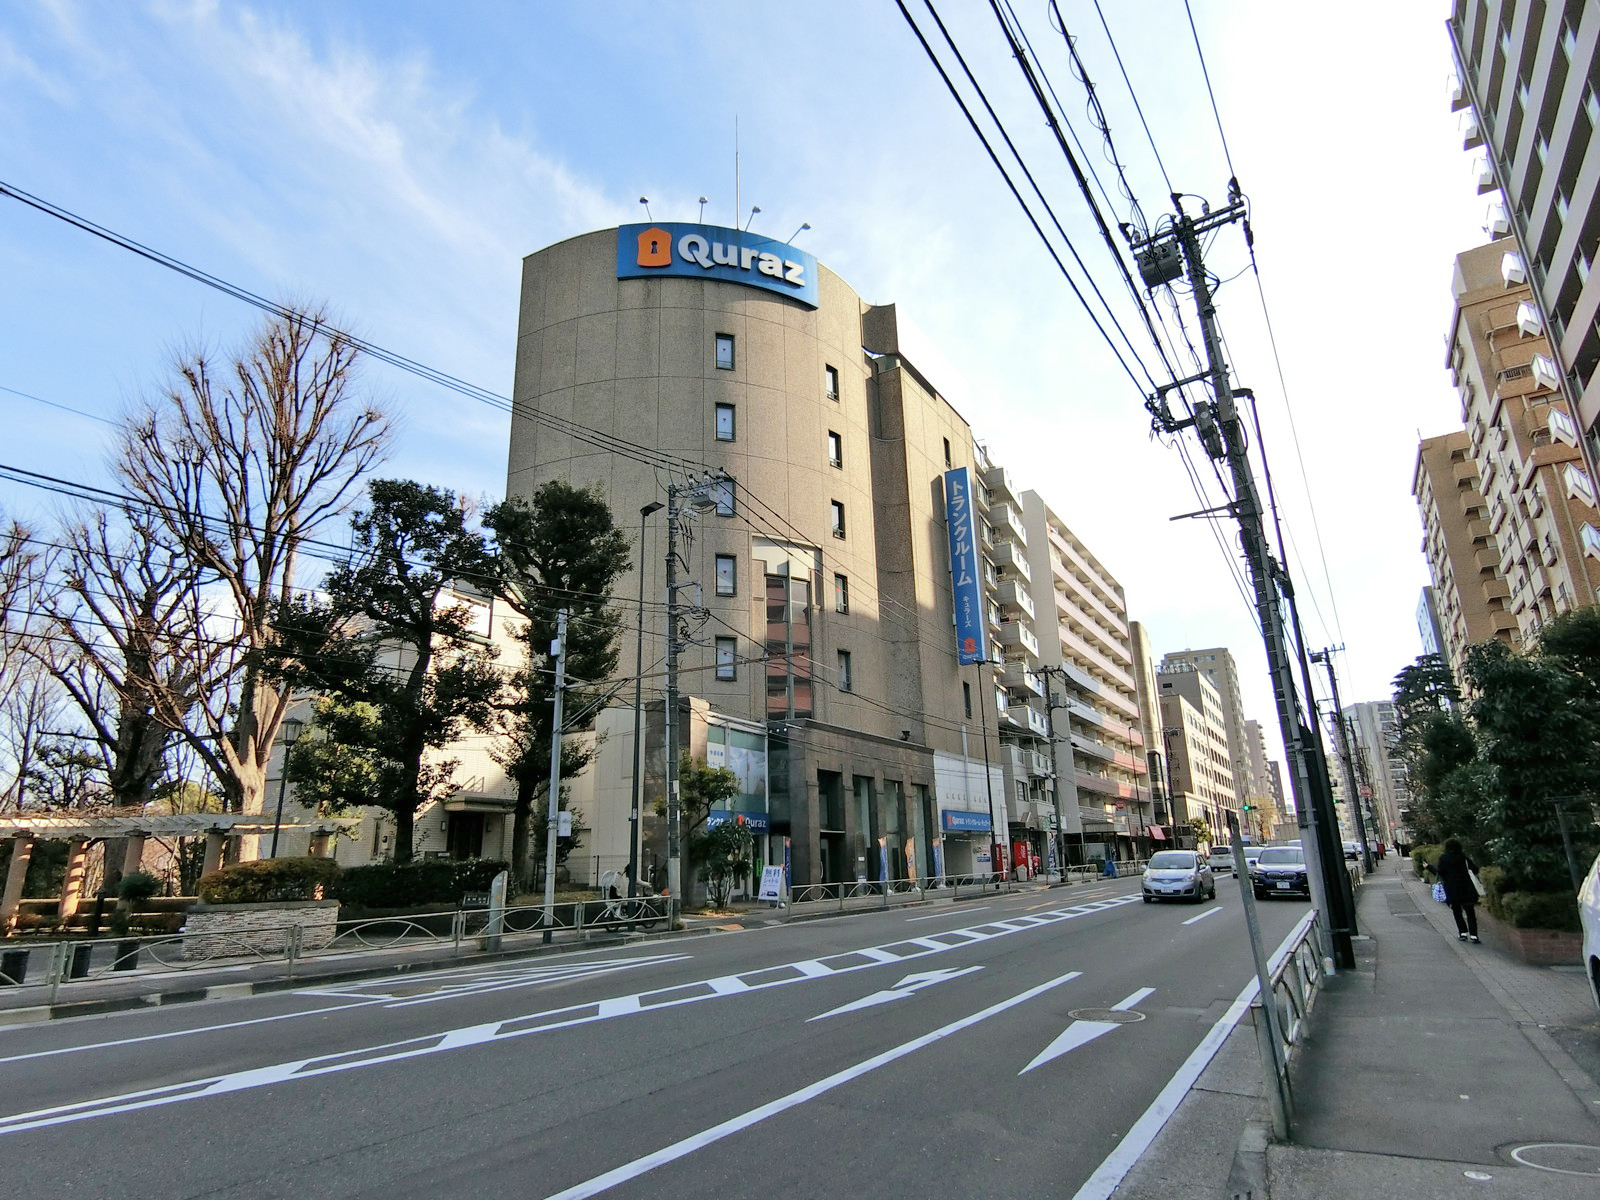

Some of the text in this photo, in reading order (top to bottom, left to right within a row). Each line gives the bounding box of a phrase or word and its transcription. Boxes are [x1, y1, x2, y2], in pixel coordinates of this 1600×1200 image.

[678, 234, 805, 287] Quraz
[951, 481, 972, 587] トランクルーム
[963, 595, 972, 628] キュラーズ
[745, 817, 767, 829] Quraz
